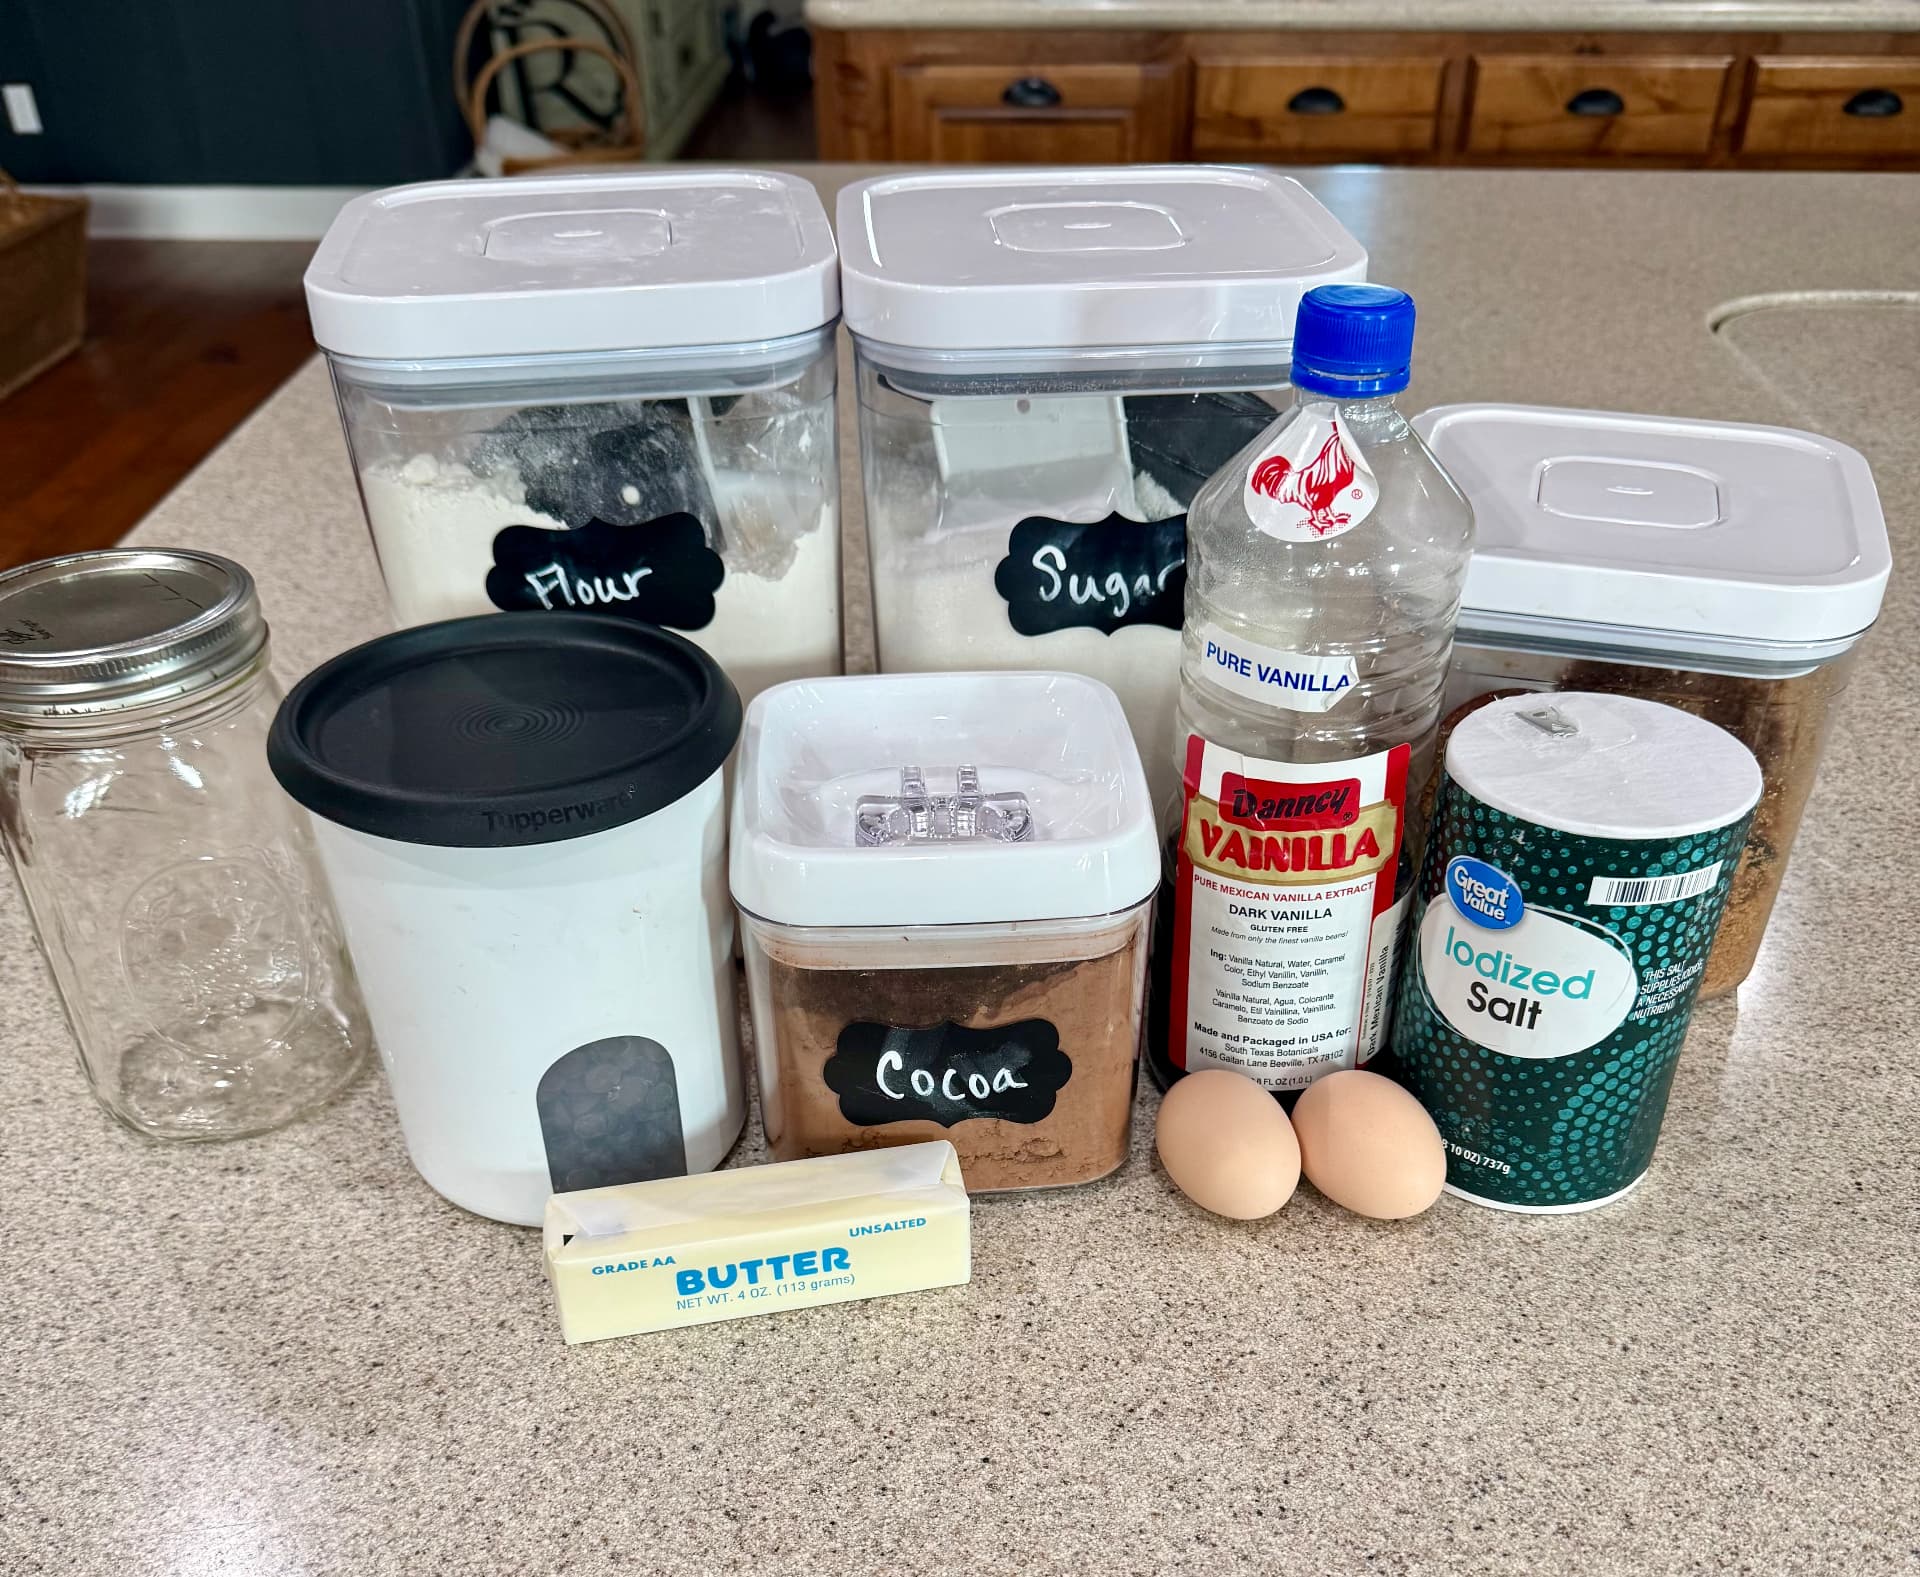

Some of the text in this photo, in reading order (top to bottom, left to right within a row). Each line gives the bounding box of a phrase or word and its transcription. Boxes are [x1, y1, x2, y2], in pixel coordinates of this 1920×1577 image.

[524, 562, 653, 610] Flour
[1032, 545, 1186, 617] Sugar
[1206, 640, 1350, 692] PURE VANILLA
[482, 791, 634, 834] Tupperware
[1232, 786, 1350, 820] Danncy
[1200, 818, 1380, 872] VAINILLA
[1194, 874, 1374, 902] PURE MEXICAN VANILLA EXTRACT
[1454, 865, 1509, 908] Great
[1229, 903, 1333, 921] DARK VANILLA
[1463, 889, 1505, 921] Value
[1211, 926, 1230, 937] Made
[1230, 931, 1246, 940] from
[1247, 935, 1264, 945] only
[1265, 936, 1277, 944] the
[1300, 935, 1324, 944] vanilla
[1325, 930, 1349, 941] beans!
[1250, 924, 1285, 933] GLUTEN
[1210, 949, 1346, 969] Ing: Vanilla Natural, Water, Caramel
[1224, 963, 1245, 976] Color,
[1247, 968, 1266, 979] Ethyl
[1300, 968, 1329, 978] Vanillin,
[1376, 945, 1390, 985] Vanilla
[1444, 927, 1596, 1000] Iodized
[1645, 960, 1687, 982] THIS SALT
[1241, 978, 1309, 989] Sodium Benzoate
[1636, 978, 1694, 1009] A NECESSARY
[1640, 975, 1681, 995] SUPPLIES
[1212, 999, 1249, 1014] Caramelo,
[1265, 1008, 1301, 1016] Vainillina,
[1215, 989, 1335, 1007] Vainilla Natural, Agua, Colorante
[1370, 986, 1384, 1031] Mexican
[1466, 981, 1544, 1030] Salt
[1633, 999, 1675, 1020] NUTRIENT
[1238, 1015, 1309, 1026] Benzoato de Sodio
[1194, 1022, 1218, 1037] Made
[1221, 1033, 1240, 1042] and
[1243, 1035, 1295, 1048] Packaged
[1312, 1031, 1333, 1042] USA
[1336, 1026, 1352, 1037] for:
[1366, 1031, 1378, 1057] Dark
[1225, 1043, 1319, 1056] South Texas Botanicals
[1247, 1058, 1268, 1067] Lane
[1270, 1059, 1305, 1068] Beeville,
[1307, 1055, 1319, 1065] TX
[876, 1050, 1029, 1100] Cocoa
[1275, 1078, 1287, 1086] OZ
[1450, 1143, 1462, 1156] 10
[1463, 1149, 1481, 1165] OZ)
[1482, 1156, 1511, 1175] 737g
[849, 1217, 927, 1237] UNSALTED
[592, 1255, 676, 1276] GRADE AA
[676, 1246, 851, 1296] BUTTER
[676, 1273, 856, 1310] NET WT. 4 OZ. (113 grams)
